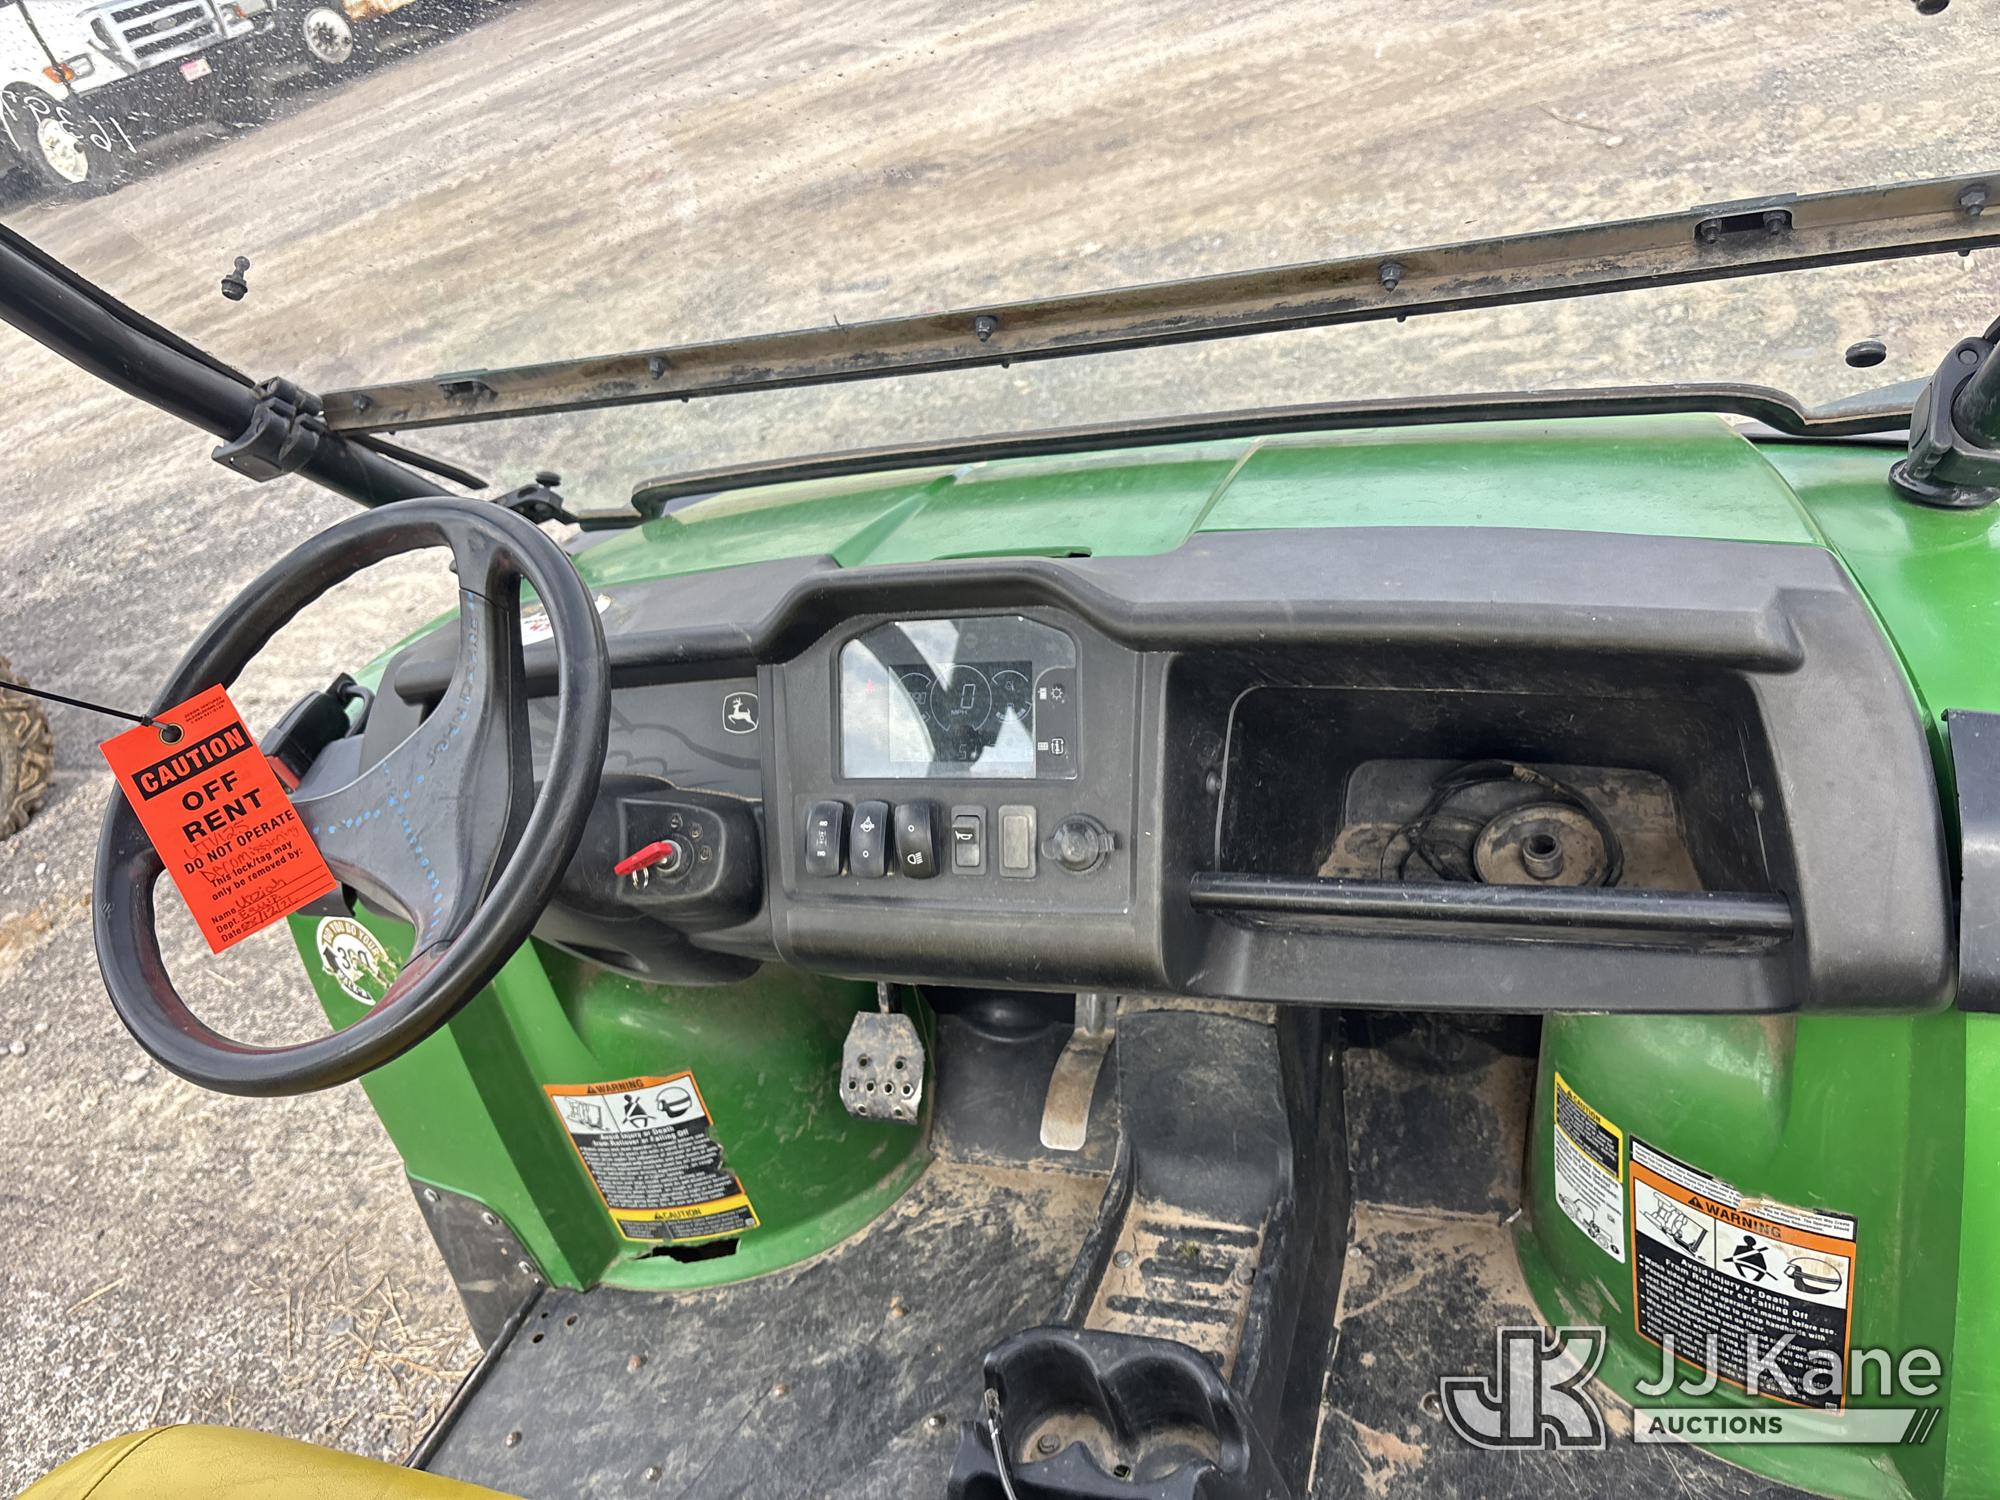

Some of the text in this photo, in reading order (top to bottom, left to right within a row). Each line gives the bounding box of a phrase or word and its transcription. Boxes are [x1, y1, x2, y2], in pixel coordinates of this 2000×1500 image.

[138, 727, 245, 794] CAUTION
[179, 769, 242, 813] OFF
[181, 787, 266, 843] RENT
[183, 808, 295, 874] DO NOT OPERATE
[210, 840, 294, 888] This lock/tag may
[210, 846, 304, 902] only be removed by:
[210, 906, 236, 924] Name
[215, 915, 240, 934] Dept.
[220, 926, 242, 942] Date
[596, 1080, 644, 1094] WARNING
[1572, 1094, 1601, 1124] CAUTION
[653, 1126, 674, 1135] Death
[677, 1128, 689, 1137] Off
[663, 1208, 702, 1219] CAUTION
[1705, 1201, 1781, 1238] WARNING
[1665, 1258, 1808, 1319] From Rollover or Falling Off
[1681, 1258, 1789, 1306] Avoid Injury or Death
[1701, 1286, 1718, 1298] read
[1720, 1294, 1757, 1313] operator's
[1760, 1309, 1789, 1323] manual
[1791, 1319, 1817, 1331] before
[1819, 1326, 1837, 1335] use.
[1742, 1312, 1763, 1324] grasp
[1765, 1319, 1806, 1336] handholds
[1808, 1332, 1825, 1341] with
